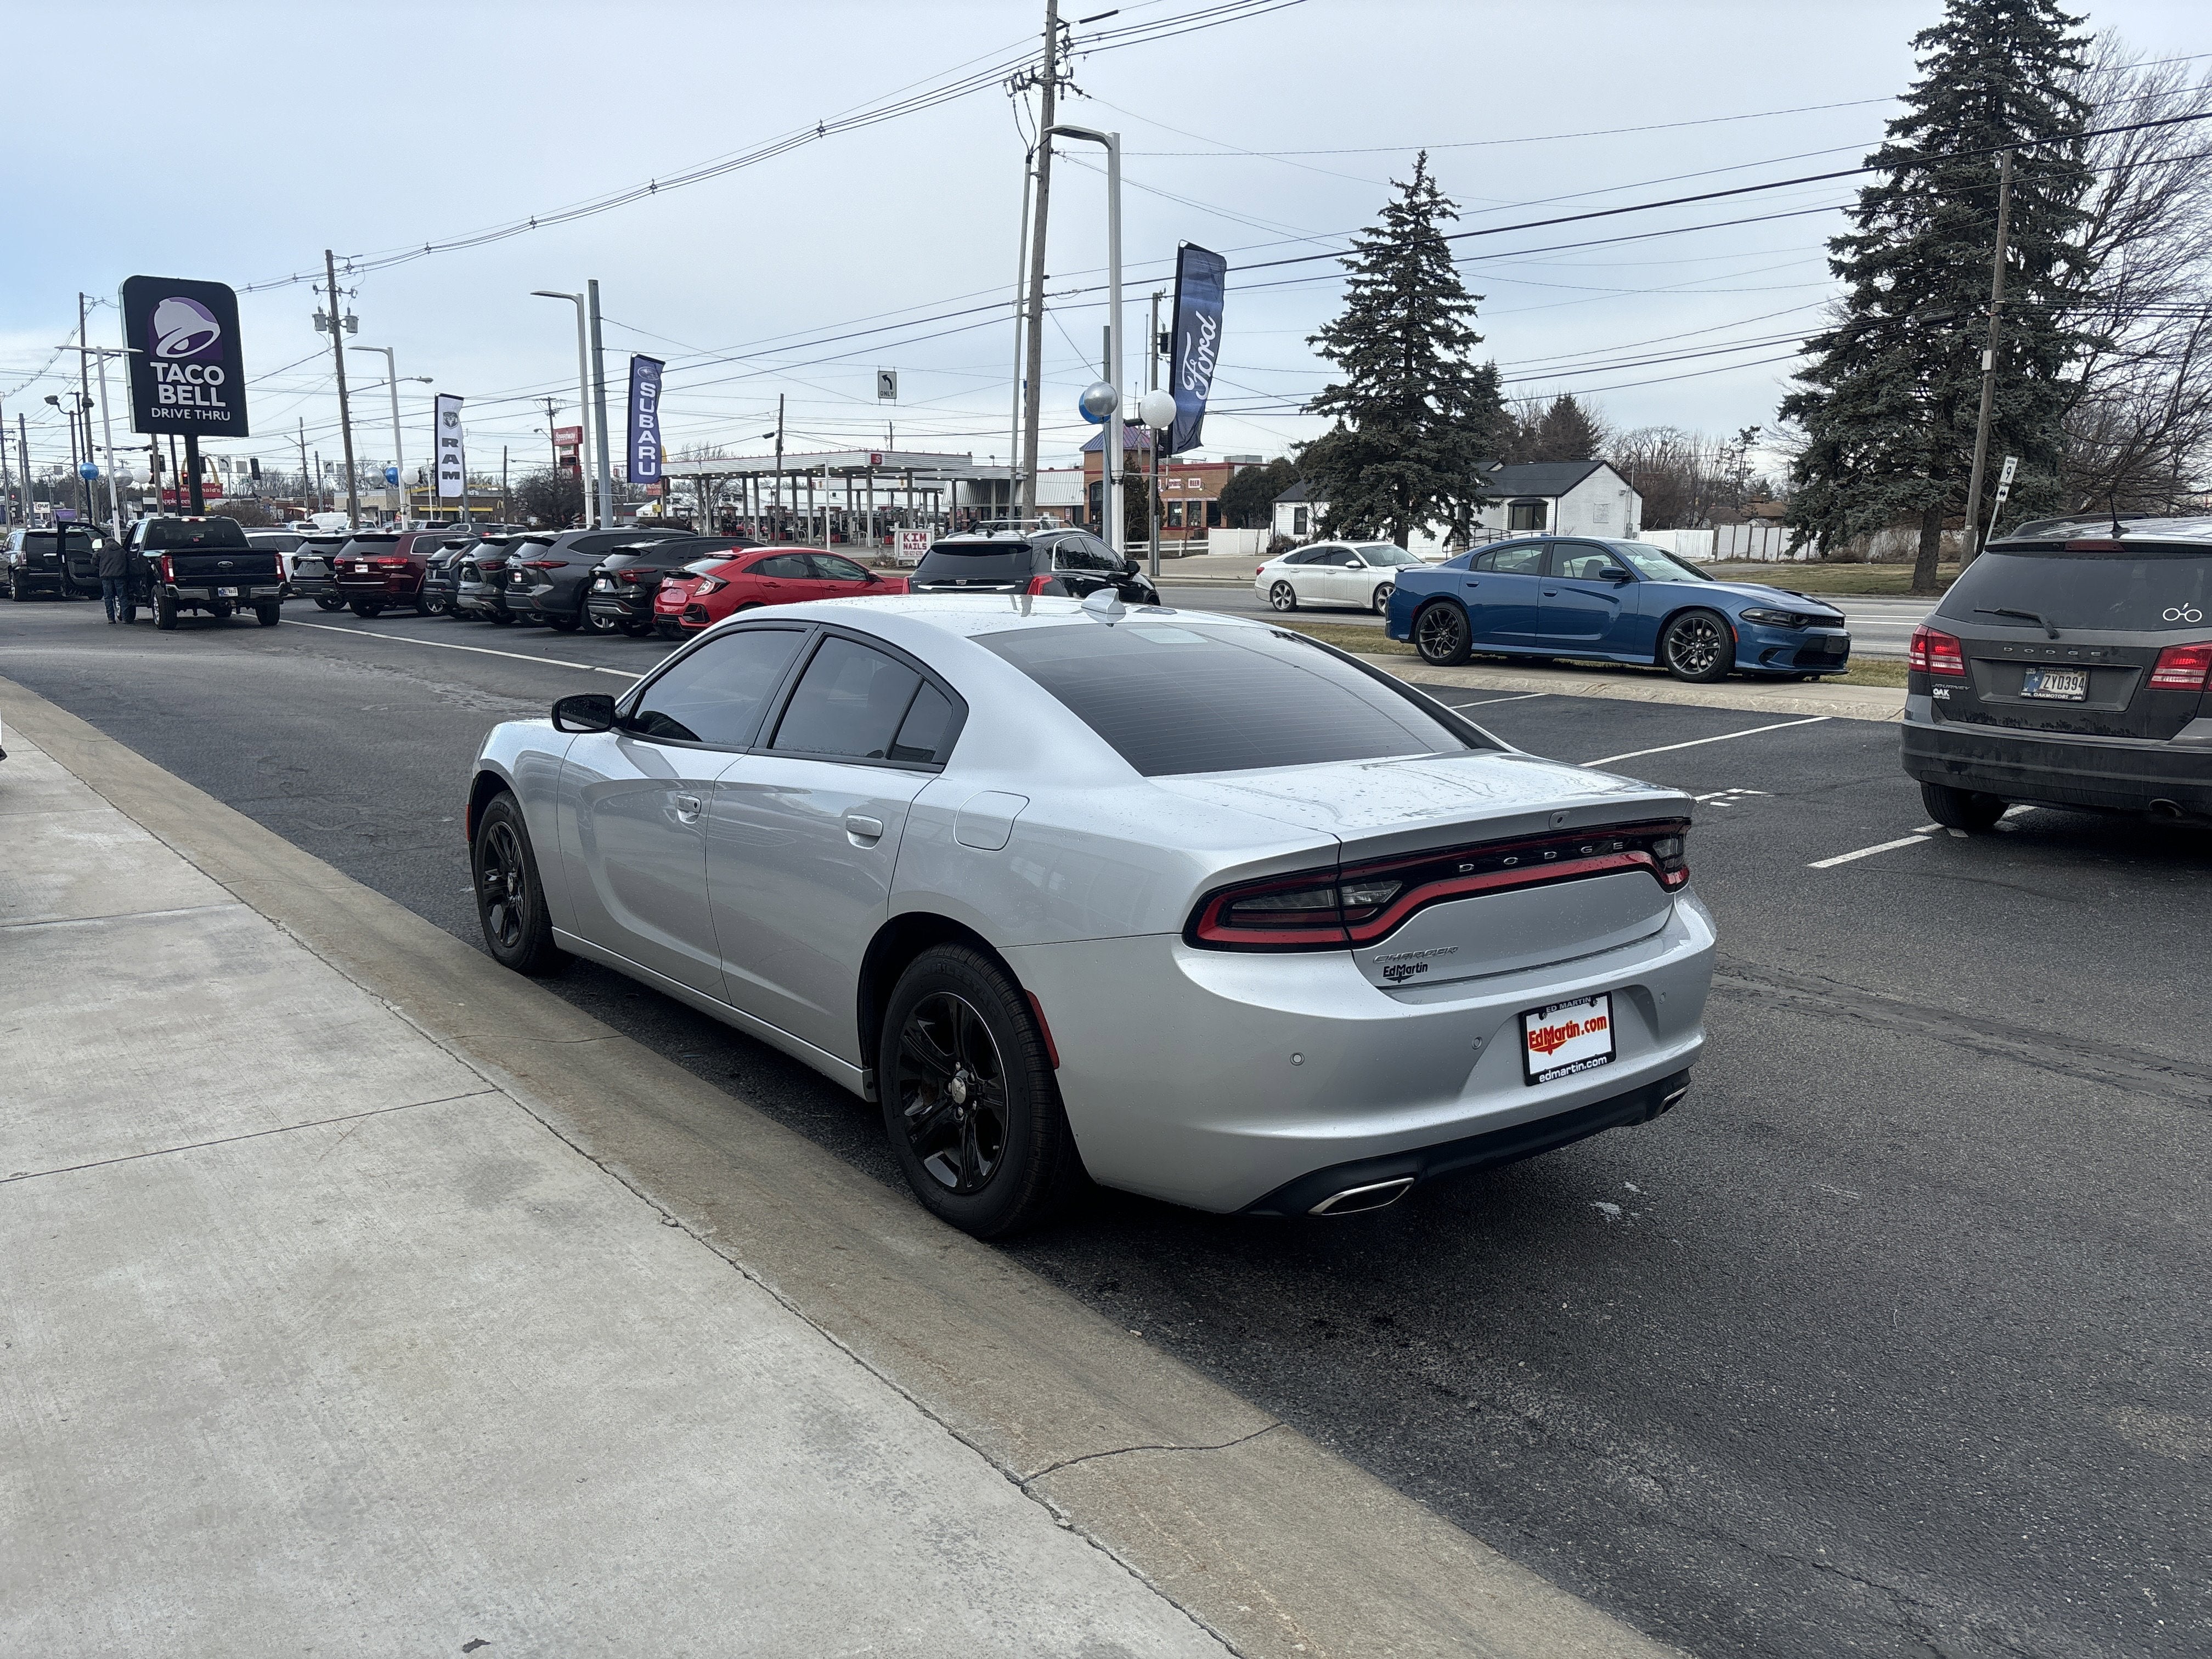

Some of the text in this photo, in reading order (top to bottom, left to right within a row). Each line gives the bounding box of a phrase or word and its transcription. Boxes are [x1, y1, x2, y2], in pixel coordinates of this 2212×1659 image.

[1182, 311, 1217, 400] Ford
[149, 362, 225, 386] TACO
[158, 384, 226, 407] BELL
[151, 407, 230, 421] DRIVE THRU
[637, 382, 657, 476] SUBARU
[442, 438, 460, 479] RAM
[2006, 466, 2012, 481] 9
[904, 533, 927, 542] KIM
[2004, 647, 2101, 657] DODGE
[1933, 688, 1950, 696] OAK
[1459, 842, 1623, 873] DODGE
[1373, 945, 1459, 964] CHARGER
[1546, 996, 1591, 1013] ED MARTIN
[1539, 1056, 1607, 1082] edmartin.com
